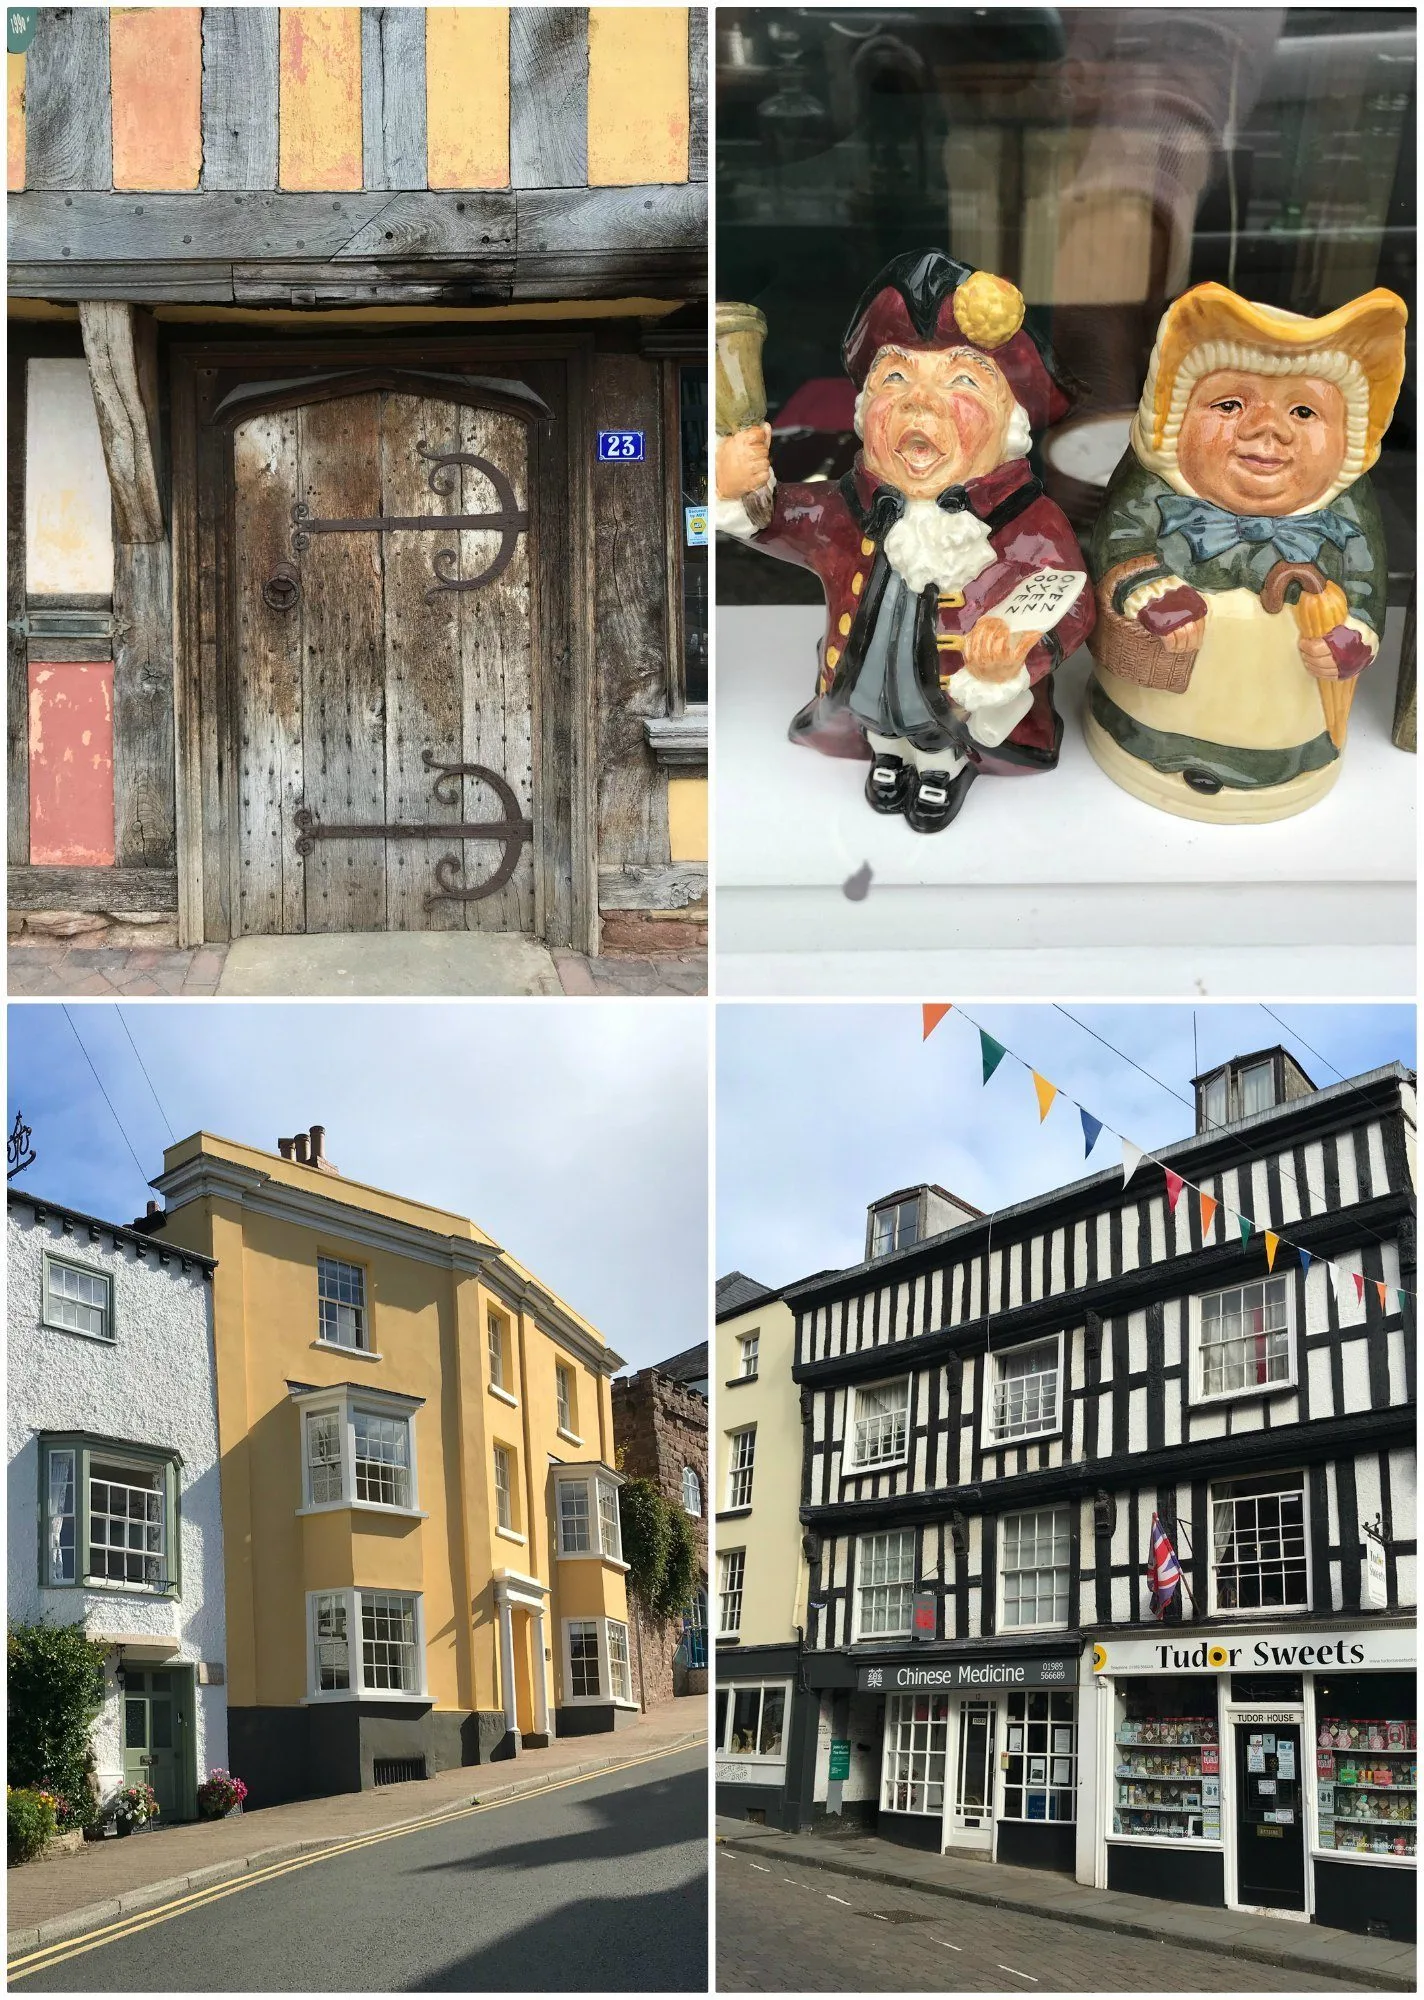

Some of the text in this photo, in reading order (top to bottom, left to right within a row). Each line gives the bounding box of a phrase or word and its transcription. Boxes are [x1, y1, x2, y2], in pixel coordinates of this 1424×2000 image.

[607, 435, 635, 457] 23
[1156, 1640, 1365, 1669] Tudor Sweets
[897, 1663, 1025, 1686] Chinese Medicine
[1040, 1671, 1066, 1680] 566689
[1042, 1661, 1064, 1671] 01989
[867, 1668, 883, 1688] 藥
[1237, 1713, 1295, 1722] TUDOR HOUSE
